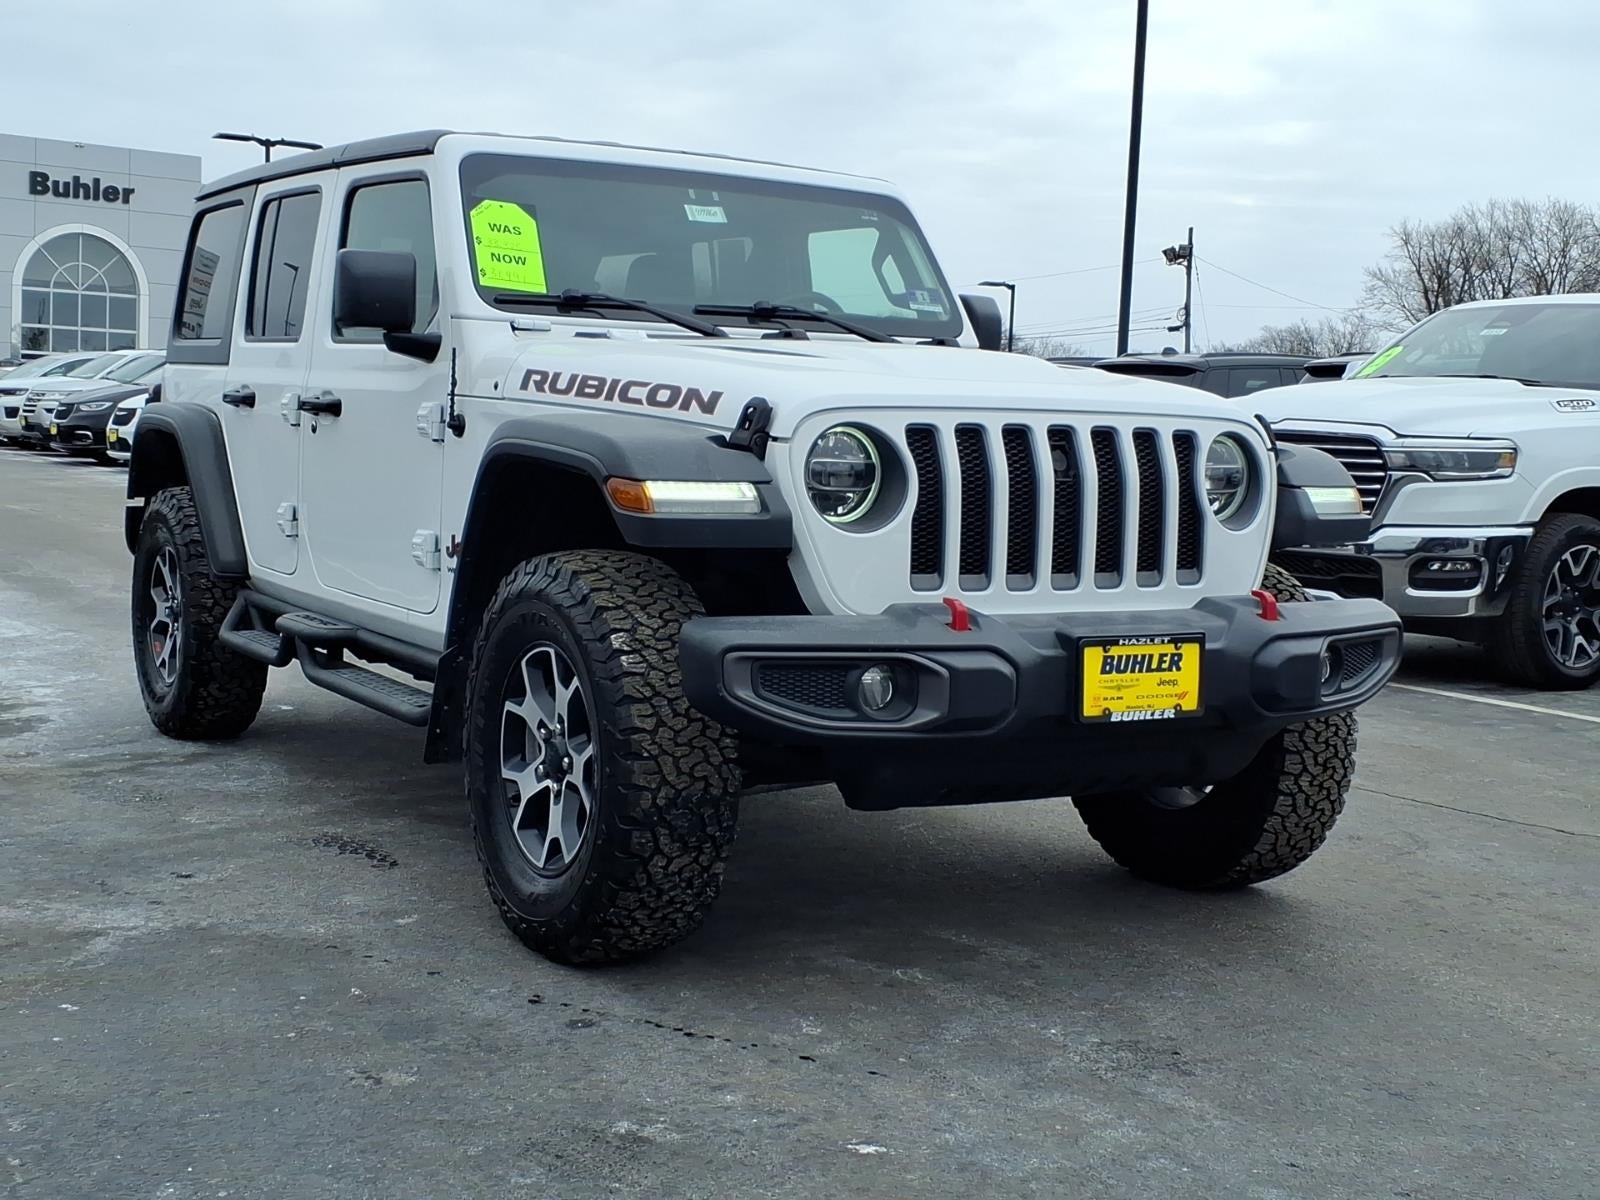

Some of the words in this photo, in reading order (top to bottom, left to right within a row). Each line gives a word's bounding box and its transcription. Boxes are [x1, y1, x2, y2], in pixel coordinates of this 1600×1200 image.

[28, 171, 135, 204] Buhler
[488, 222, 522, 236] WAS
[475, 236, 482, 245] $
[490, 252, 527, 266] NOW
[480, 268, 487, 277] $
[519, 368, 724, 416] RUBICON
[1559, 400, 1592, 408] 1500
[1118, 637, 1171, 646] HAZLET
[1100, 652, 1183, 675] BUHLER
[1157, 677, 1178, 688] Jeep
[1110, 708, 1176, 722] BUHLER
